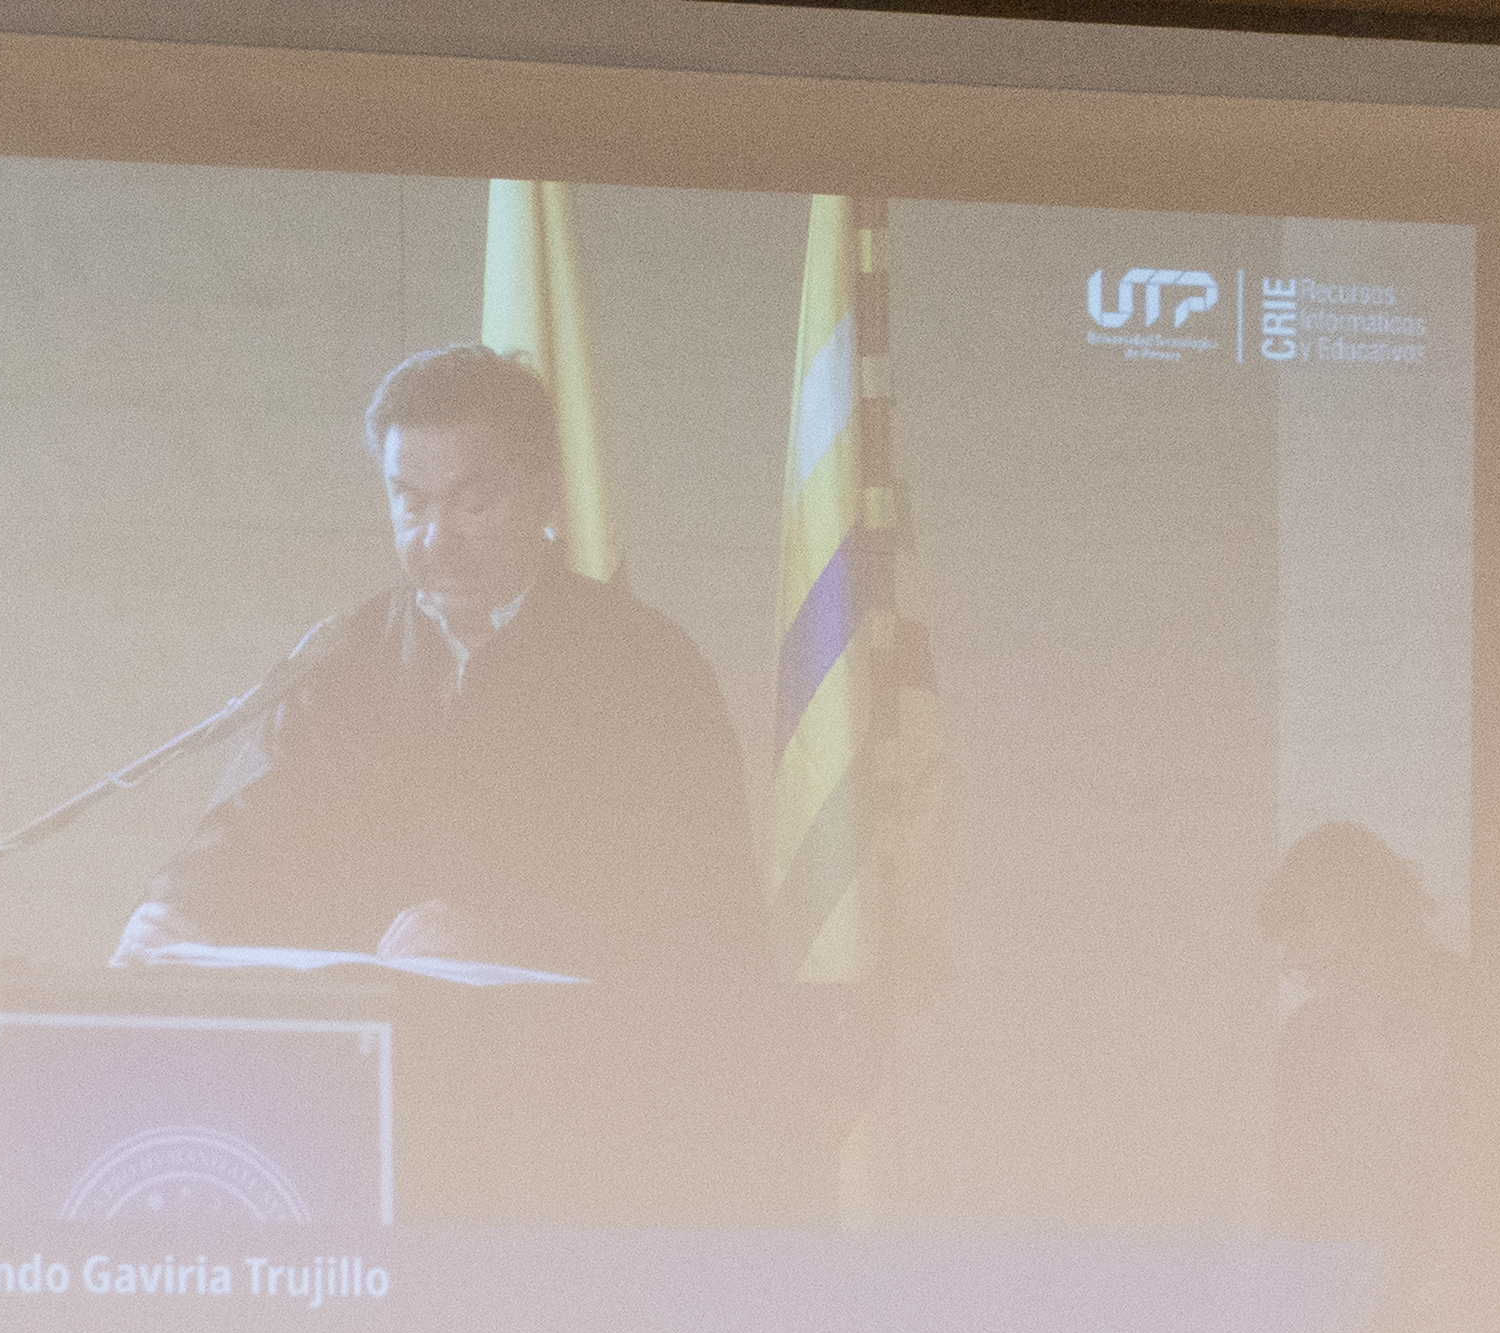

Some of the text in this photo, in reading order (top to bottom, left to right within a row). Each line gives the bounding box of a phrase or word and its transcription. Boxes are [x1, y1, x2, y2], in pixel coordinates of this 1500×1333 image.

[1087, 267, 1219, 328] UTP
[1261, 277, 1297, 360] CRIE
[83, 1254, 232, 1295] Gaviria
[245, 1256, 390, 1308] Trujillo
